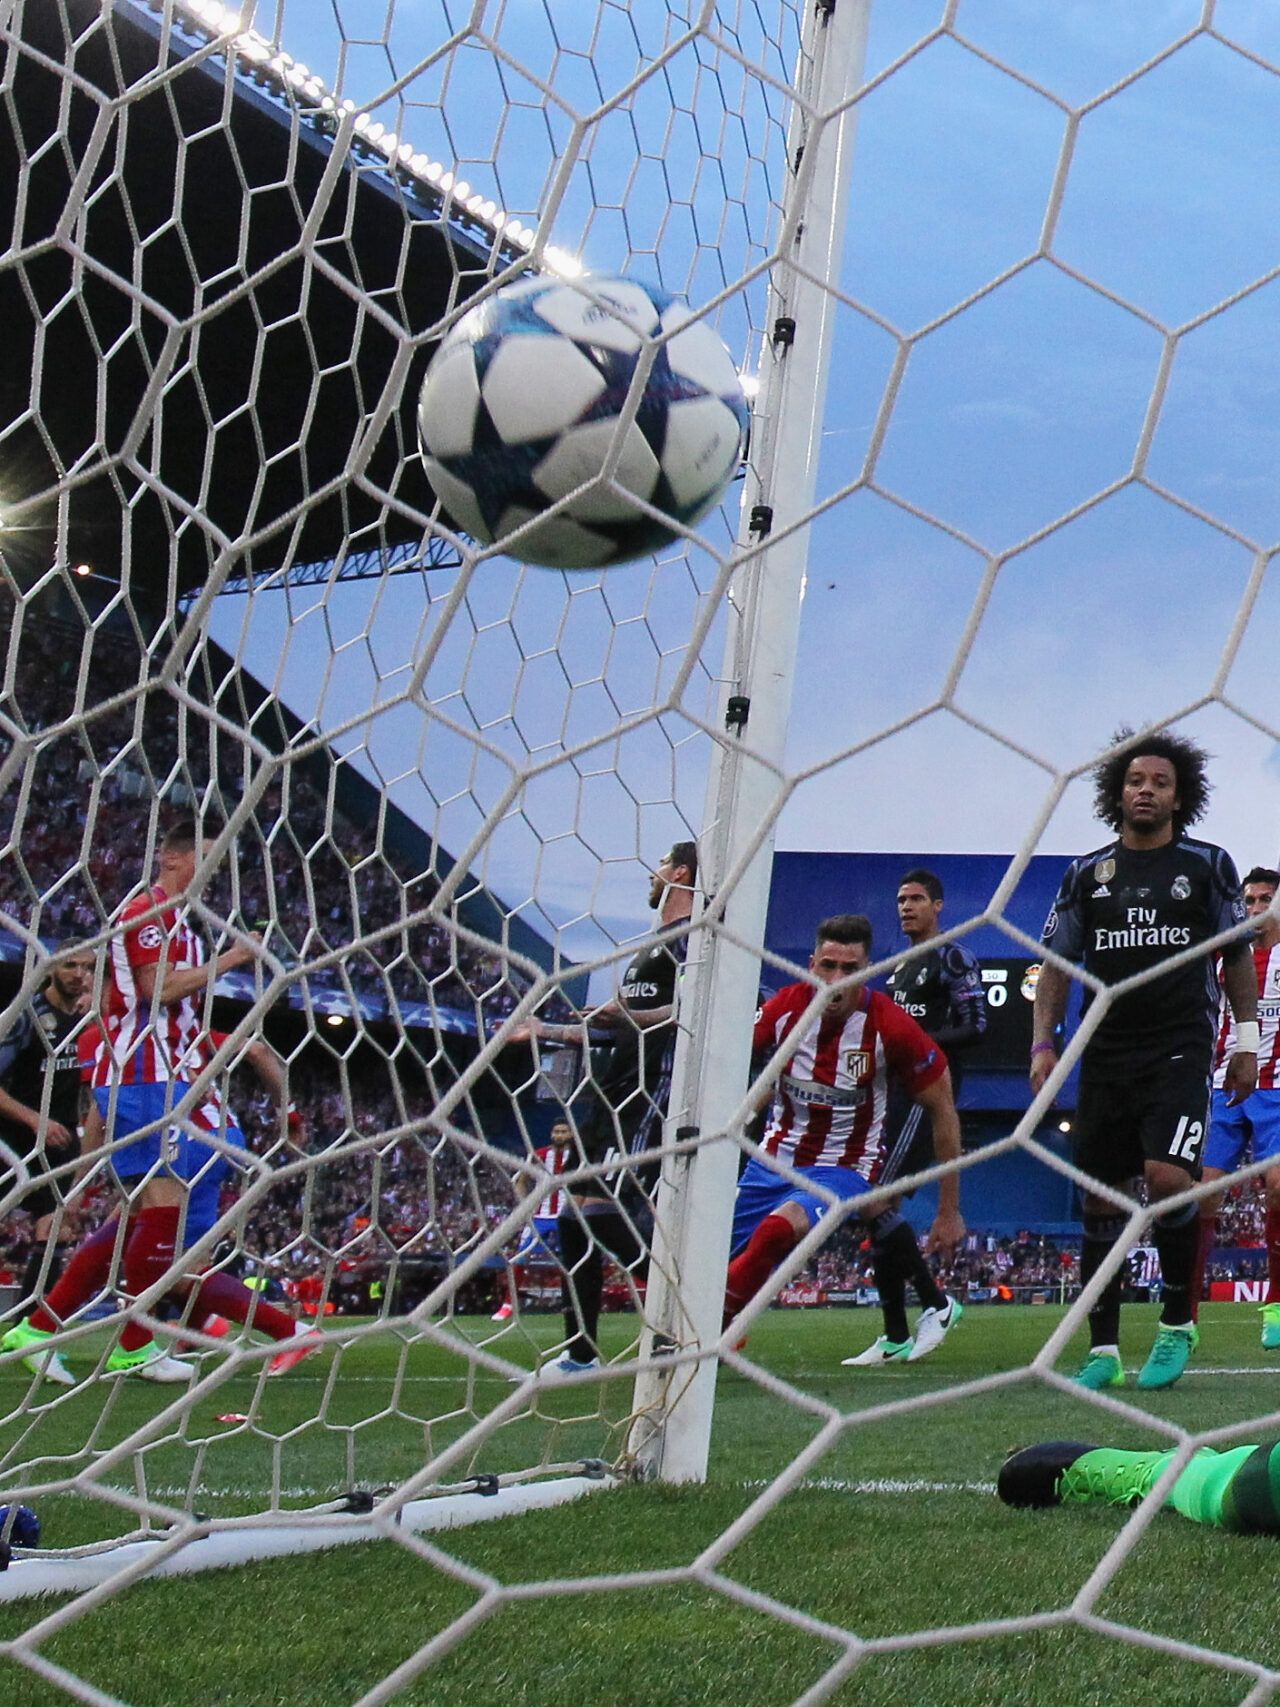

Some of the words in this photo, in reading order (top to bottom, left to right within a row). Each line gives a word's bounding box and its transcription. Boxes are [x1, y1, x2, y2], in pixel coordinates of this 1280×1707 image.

[1127, 907, 1157, 925] Fly
[1095, 924, 1191, 951] Emirates
[987, 985, 1008, 1007] 0
[1168, 1115, 1203, 1162] 12
